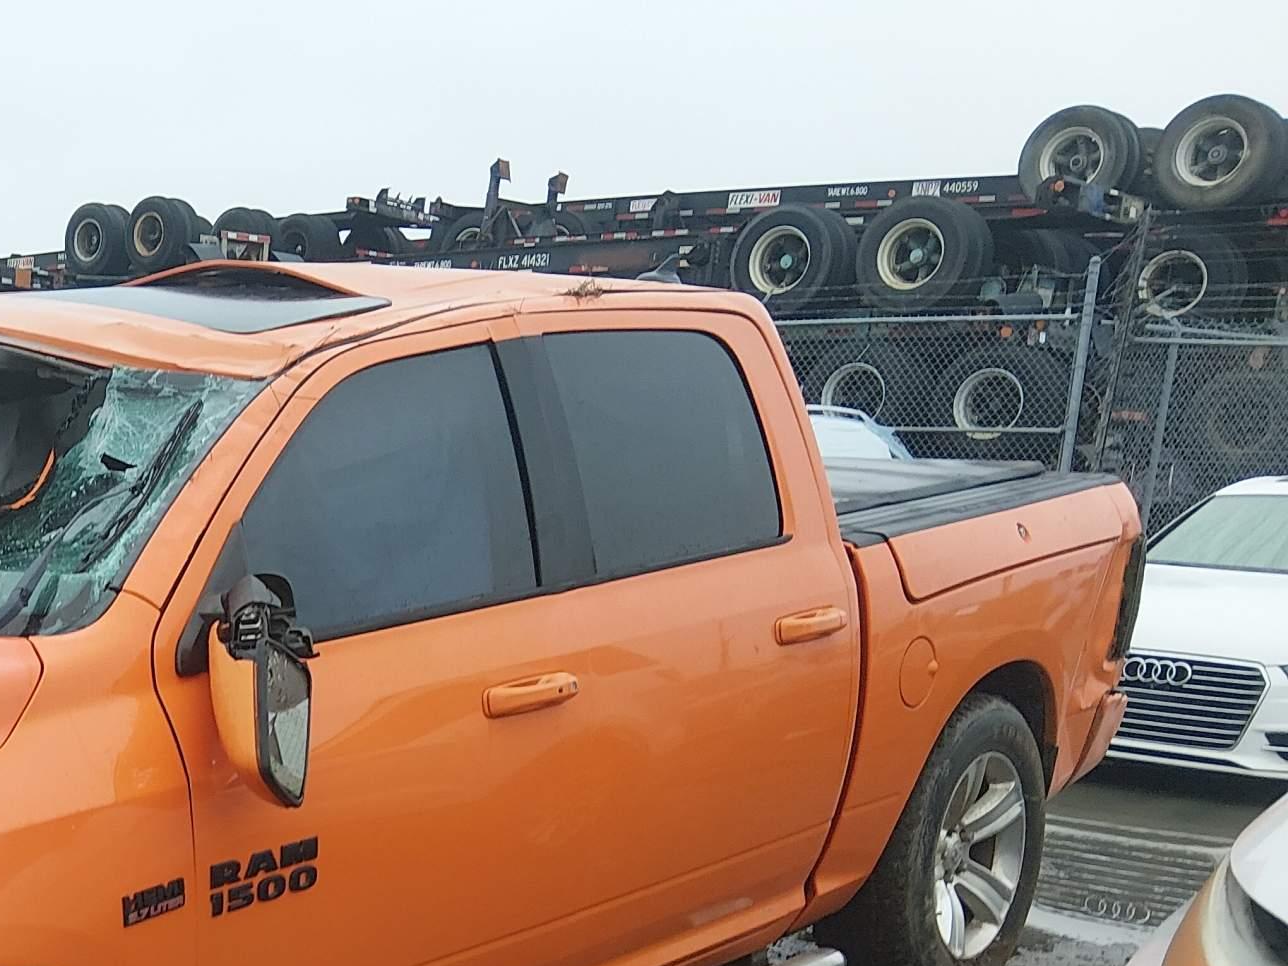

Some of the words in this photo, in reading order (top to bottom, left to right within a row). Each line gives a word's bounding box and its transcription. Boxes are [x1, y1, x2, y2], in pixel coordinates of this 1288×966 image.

[943, 180, 979, 193] 440559
[730, 192, 779, 206] FLEXI-VAN
[498, 256, 519, 269] FLXZ
[521, 252, 550, 267] 414321
[209, 836, 318, 890] RAM
[209, 864, 318, 918] 1500
[150, 895, 184, 917] LITER
